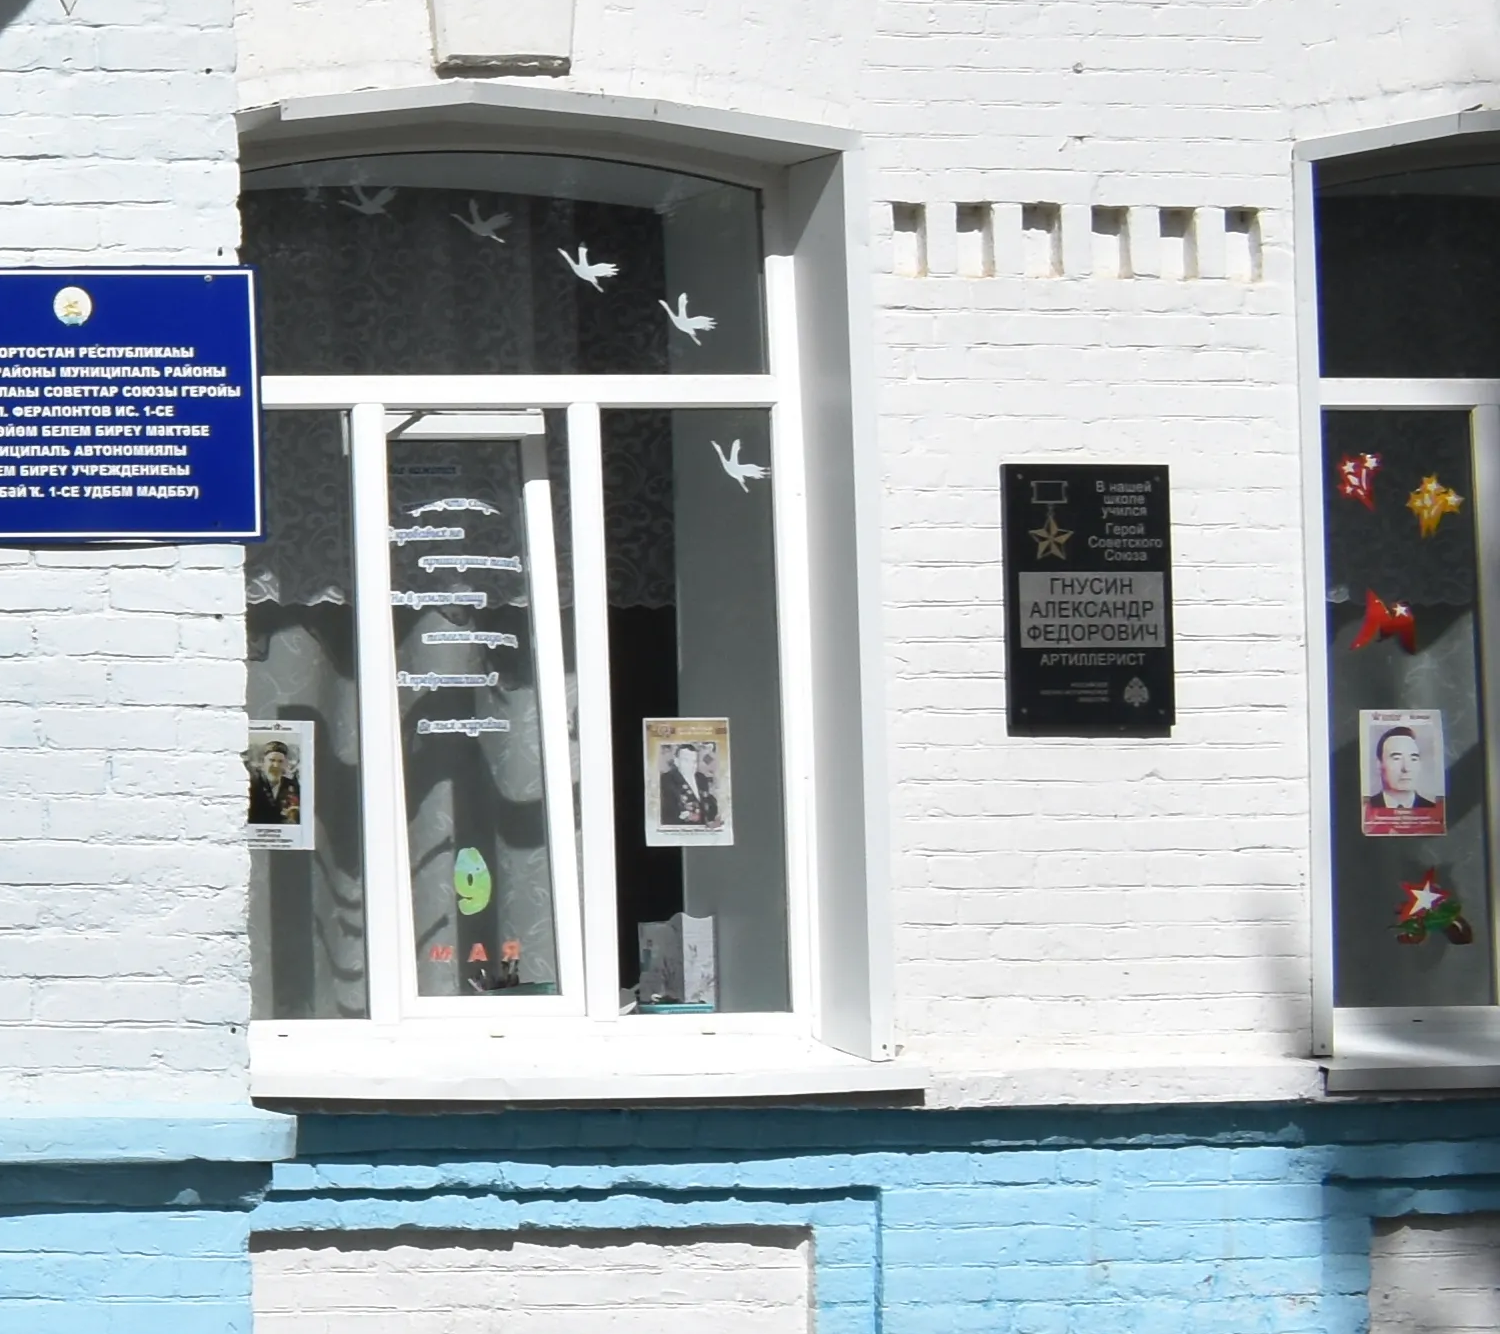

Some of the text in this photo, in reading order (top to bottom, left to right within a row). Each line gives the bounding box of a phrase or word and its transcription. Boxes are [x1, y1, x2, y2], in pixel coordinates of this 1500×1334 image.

[60, 367, 160, 380] МУНИЦИПАЛЬ
[164, 364, 226, 378] РАЙОНЫ
[44, 386, 118, 398] СОВЕТТАР
[122, 386, 177, 397] СОЮЗЫ
[181, 384, 241, 397] ГЕРОЙЫ
[12, 406, 111, 417] ФЕРАПОНТОВ
[115, 406, 139, 417] ИС.
[143, 405, 174, 417] 1-СЕ
[42, 425, 91, 437] БЕЛЕМ
[74, 445, 187, 456] АВТОНОМИЯЛЫ
[49, 486, 79, 497] 1-СЕ
[1096, 481, 1152, 493] В нашей
[1104, 494, 1145, 505] школе
[1102, 507, 1147, 518] учился
[1105, 523, 1144, 536] Герой
[1088, 537, 1162, 548] Советского
[1105, 550, 1147, 561] Союза
[1050, 578, 1133, 594] ГНУСИН
[1030, 601, 1154, 621] АЛЕКСАНДР
[1027, 624, 1158, 644] ФЕДОРОВИЧ
[1040, 653, 1146, 666] АРТИЛЛЕРИСТ
[454, 847, 491, 915] 9
